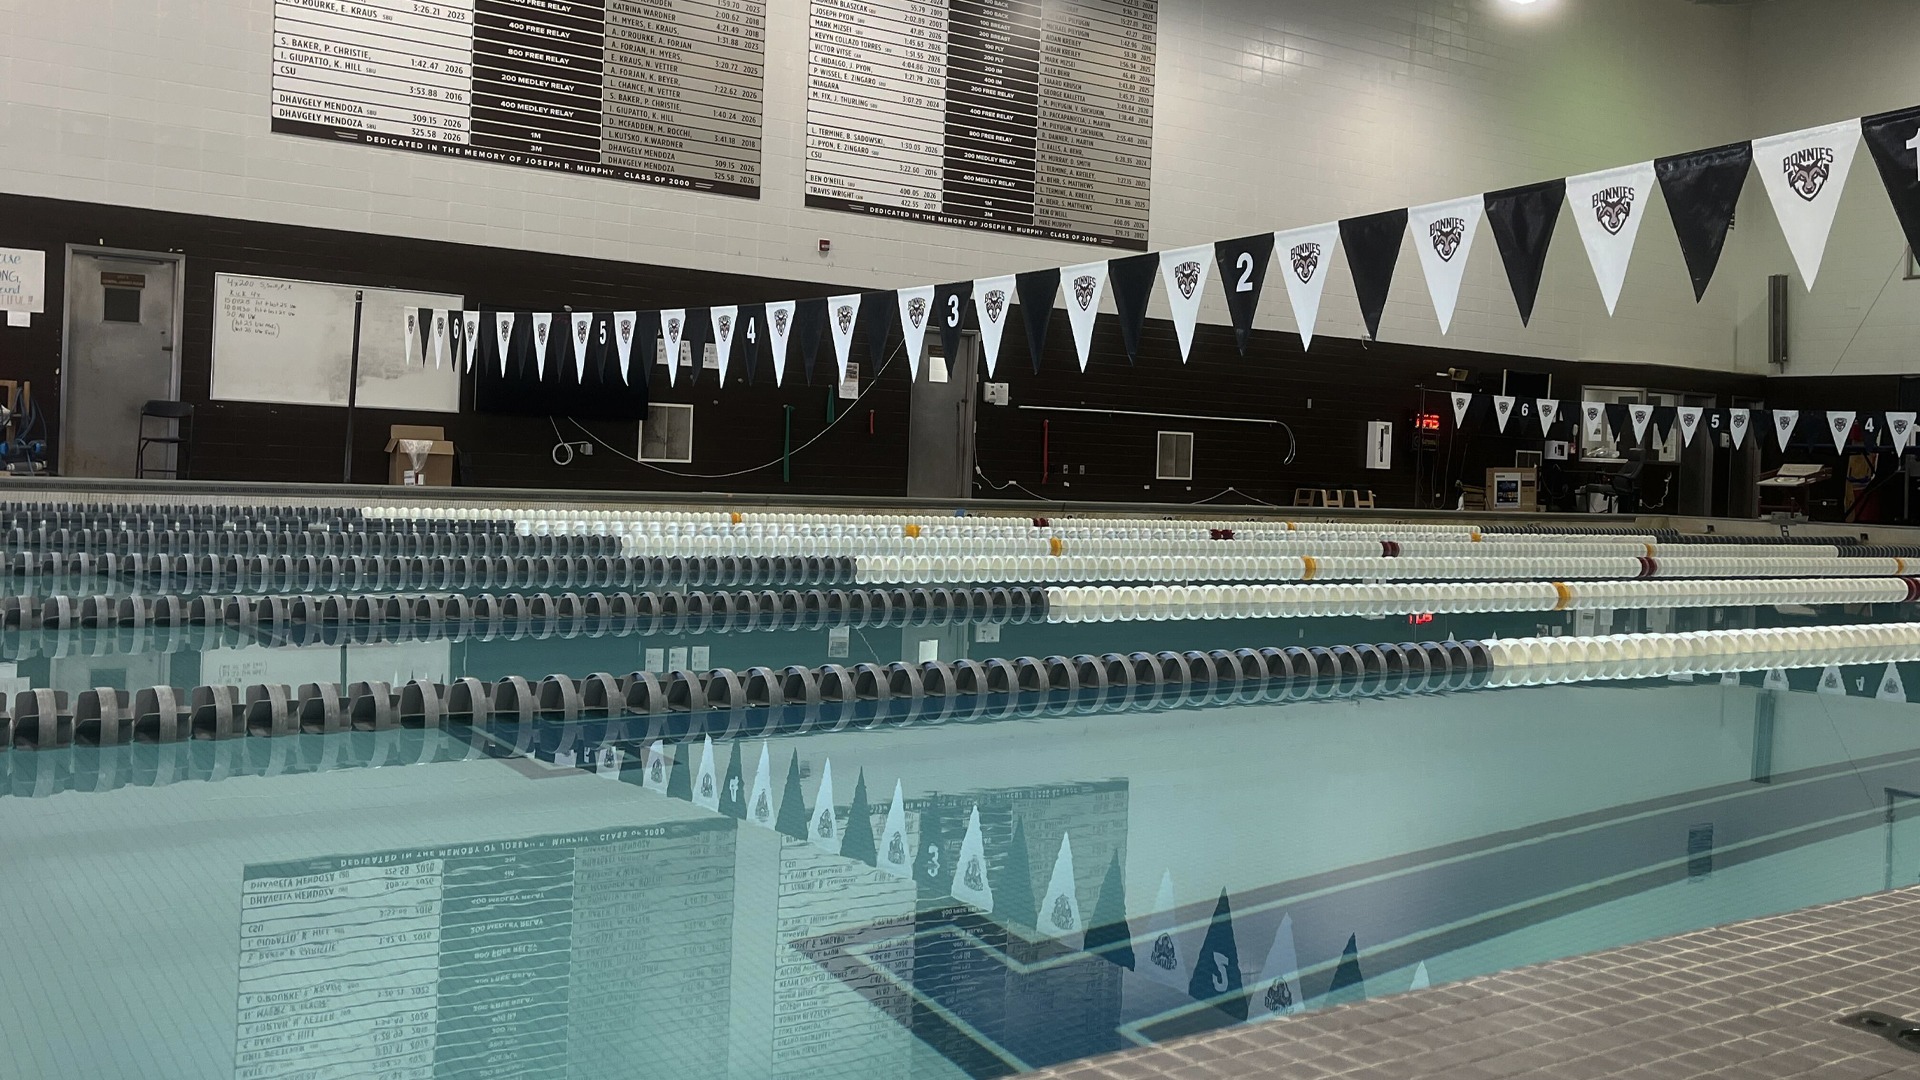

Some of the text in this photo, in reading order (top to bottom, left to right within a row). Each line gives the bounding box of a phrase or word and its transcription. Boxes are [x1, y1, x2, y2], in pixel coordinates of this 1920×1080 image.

[341, 5, 348, 13] E.
[351, 6, 378, 18] KRAUS
[414, 4, 465, 20] 3:26.21 2023
[613, 3, 642, 14] KATRINA
[644, 9, 676, 21] WARDNER
[716, 24, 739, 34] 4:21.49
[745, 29, 759, 38] 2018
[508, 22, 570, 39] 400 FREE RELAY
[613, 15, 619, 23] H.
[656, 24, 679, 35] KRAUS,
[612, 28, 619, 36] A.
[667, 39, 692, 50] FORJAN
[861, 42, 881, 51] TORRES
[281, 37, 463, 74] S. BAKER, P. CHRISTIE, 1:42.47 2026
[290, 53, 331, 67] GIUPATTO,
[334, 60, 342, 68] K.
[345, 62, 362, 72] HILL
[508, 48, 570, 65] 800 FREE RELAY
[280, 66, 296, 75] CSU
[502, 74, 574, 92] 200 MEDLEY RELAY
[813, 80, 839, 90] NIAGARA
[410, 86, 462, 101] 3:53.88 2016
[280, 94, 322, 108] DHAVGELY
[324, 101, 363, 114] MENDOZA
[413, 114, 436, 124] 309.15
[443, 119, 462, 128] 2026
[517, 104, 548, 114] MEDLEY
[550, 108, 574, 118] RELAY
[279, 108, 322, 122] DHAVGELY
[324, 115, 363, 128] MENDOZA
[411, 128, 436, 138] 325.58
[443, 132, 461, 141] 2026
[619, 119, 656, 132] MCFADDEN,
[658, 126, 665, 134] M.
[742, 139, 755, 148] 2018
[366, 135, 423, 149] DEDICATED
[442, 146, 460, 154] THE
[465, 150, 505, 160] MEMORY
[526, 158, 561, 168] JOSEPH
[577, 165, 614, 176] MURPHY
[624, 172, 651, 181] CLASS
[669, 178, 690, 186] 2000
[609, 144, 754, 172] DHAVGELY MENDOZA 309.15 2026
[811, 150, 822, 158] CSU
[976, 154, 998, 162] MEDLEY
[1782, 148, 1834, 174] BONNIES
[608, 156, 754, 184] DHAVGELY MENDOZA 325.58 2026
[810, 175, 822, 183] BEN
[924, 191, 936, 199] 2026
[810, 186, 830, 195] TRAVIS
[832, 189, 854, 199] WRIGHT
[1592, 187, 1634, 209] BONNIES
[870, 207, 910, 218] DEDICATED
[938, 217, 966, 225] MEMORY
[981, 222, 1005, 230] JOSEPH
[1017, 227, 1043, 235] MURPHY
[1050, 231, 1069, 239] CLASS
[1430, 217, 1465, 238] BONNIES
[1290, 243, 1321, 262] BONNIES
[1175, 262, 1200, 278] BONNIES
[1236, 252, 1254, 292] 2
[947, 294, 959, 328] 3
[453, 318, 459, 340] 6
[599, 320, 607, 345] 5
[747, 317, 756, 344] 4
[1521, 403, 1529, 417] 6
[1711, 414, 1720, 429] 5
[1865, 418, 1874, 432] 4
